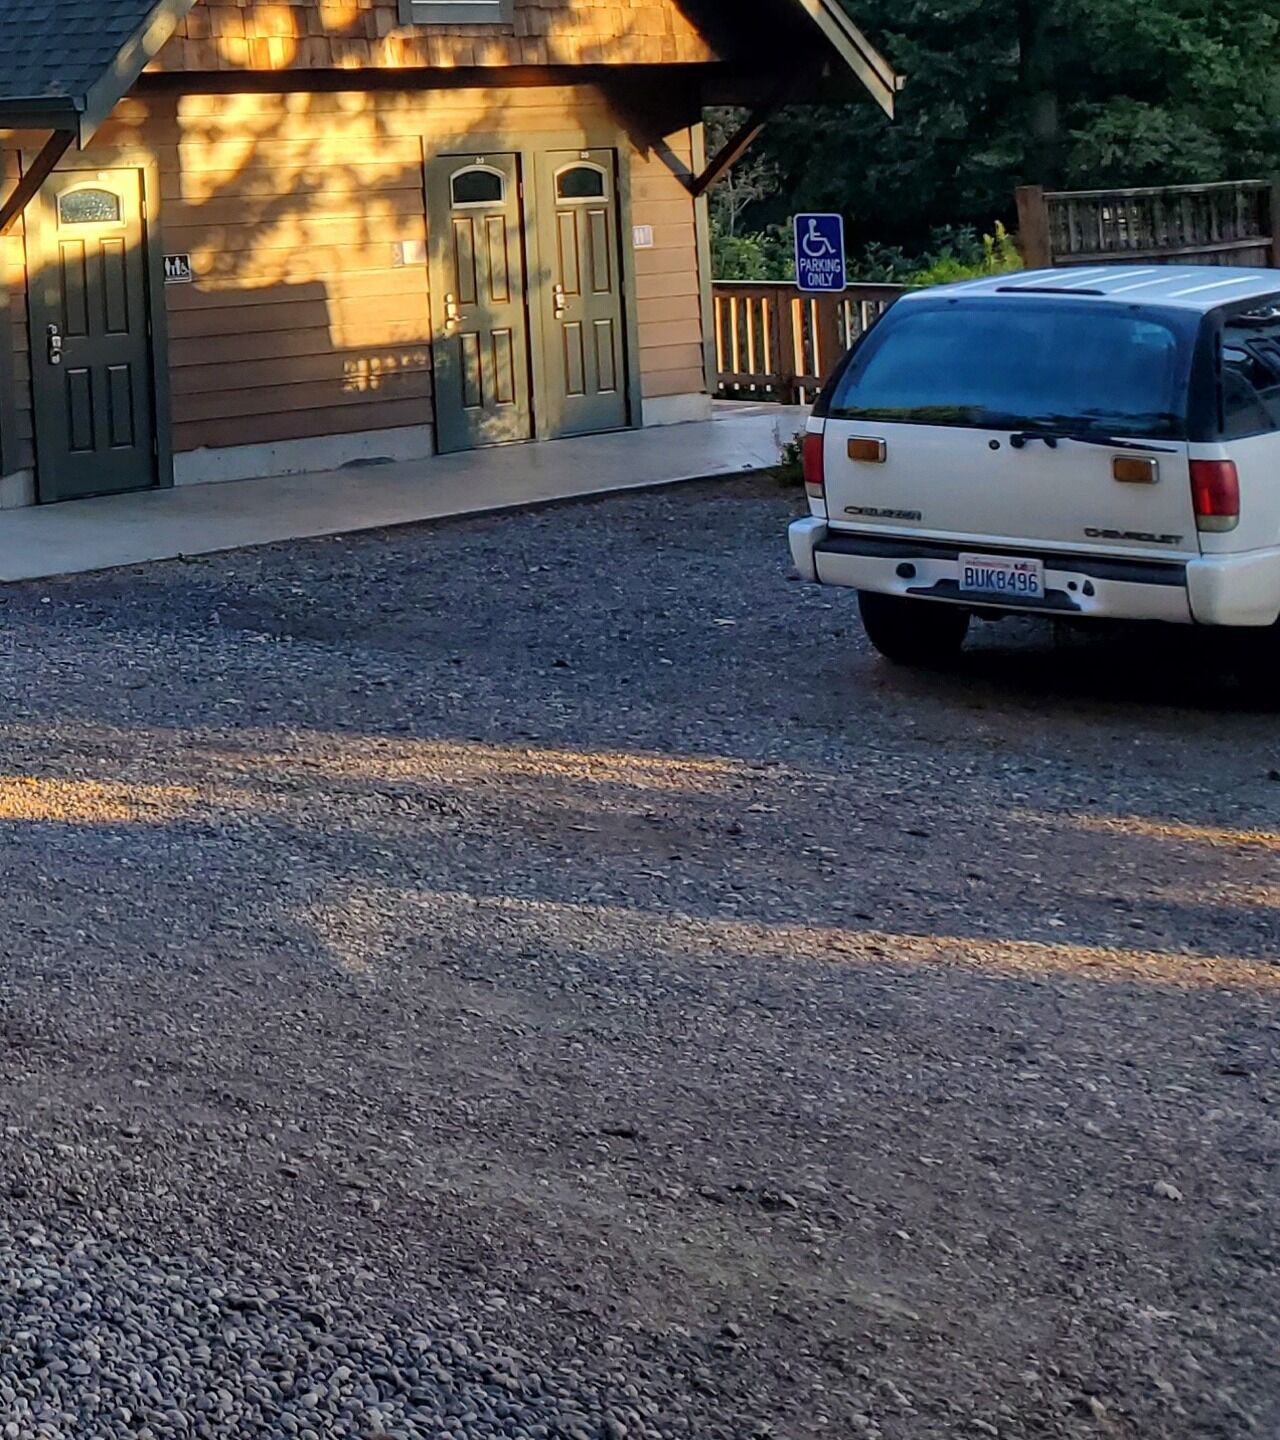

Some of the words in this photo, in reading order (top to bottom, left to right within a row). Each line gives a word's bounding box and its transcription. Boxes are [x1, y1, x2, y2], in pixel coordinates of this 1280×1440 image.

[799, 258, 841, 273] PARKING
[807, 272, 834, 287] ONLY
[964, 567, 1038, 593] BUK8496
